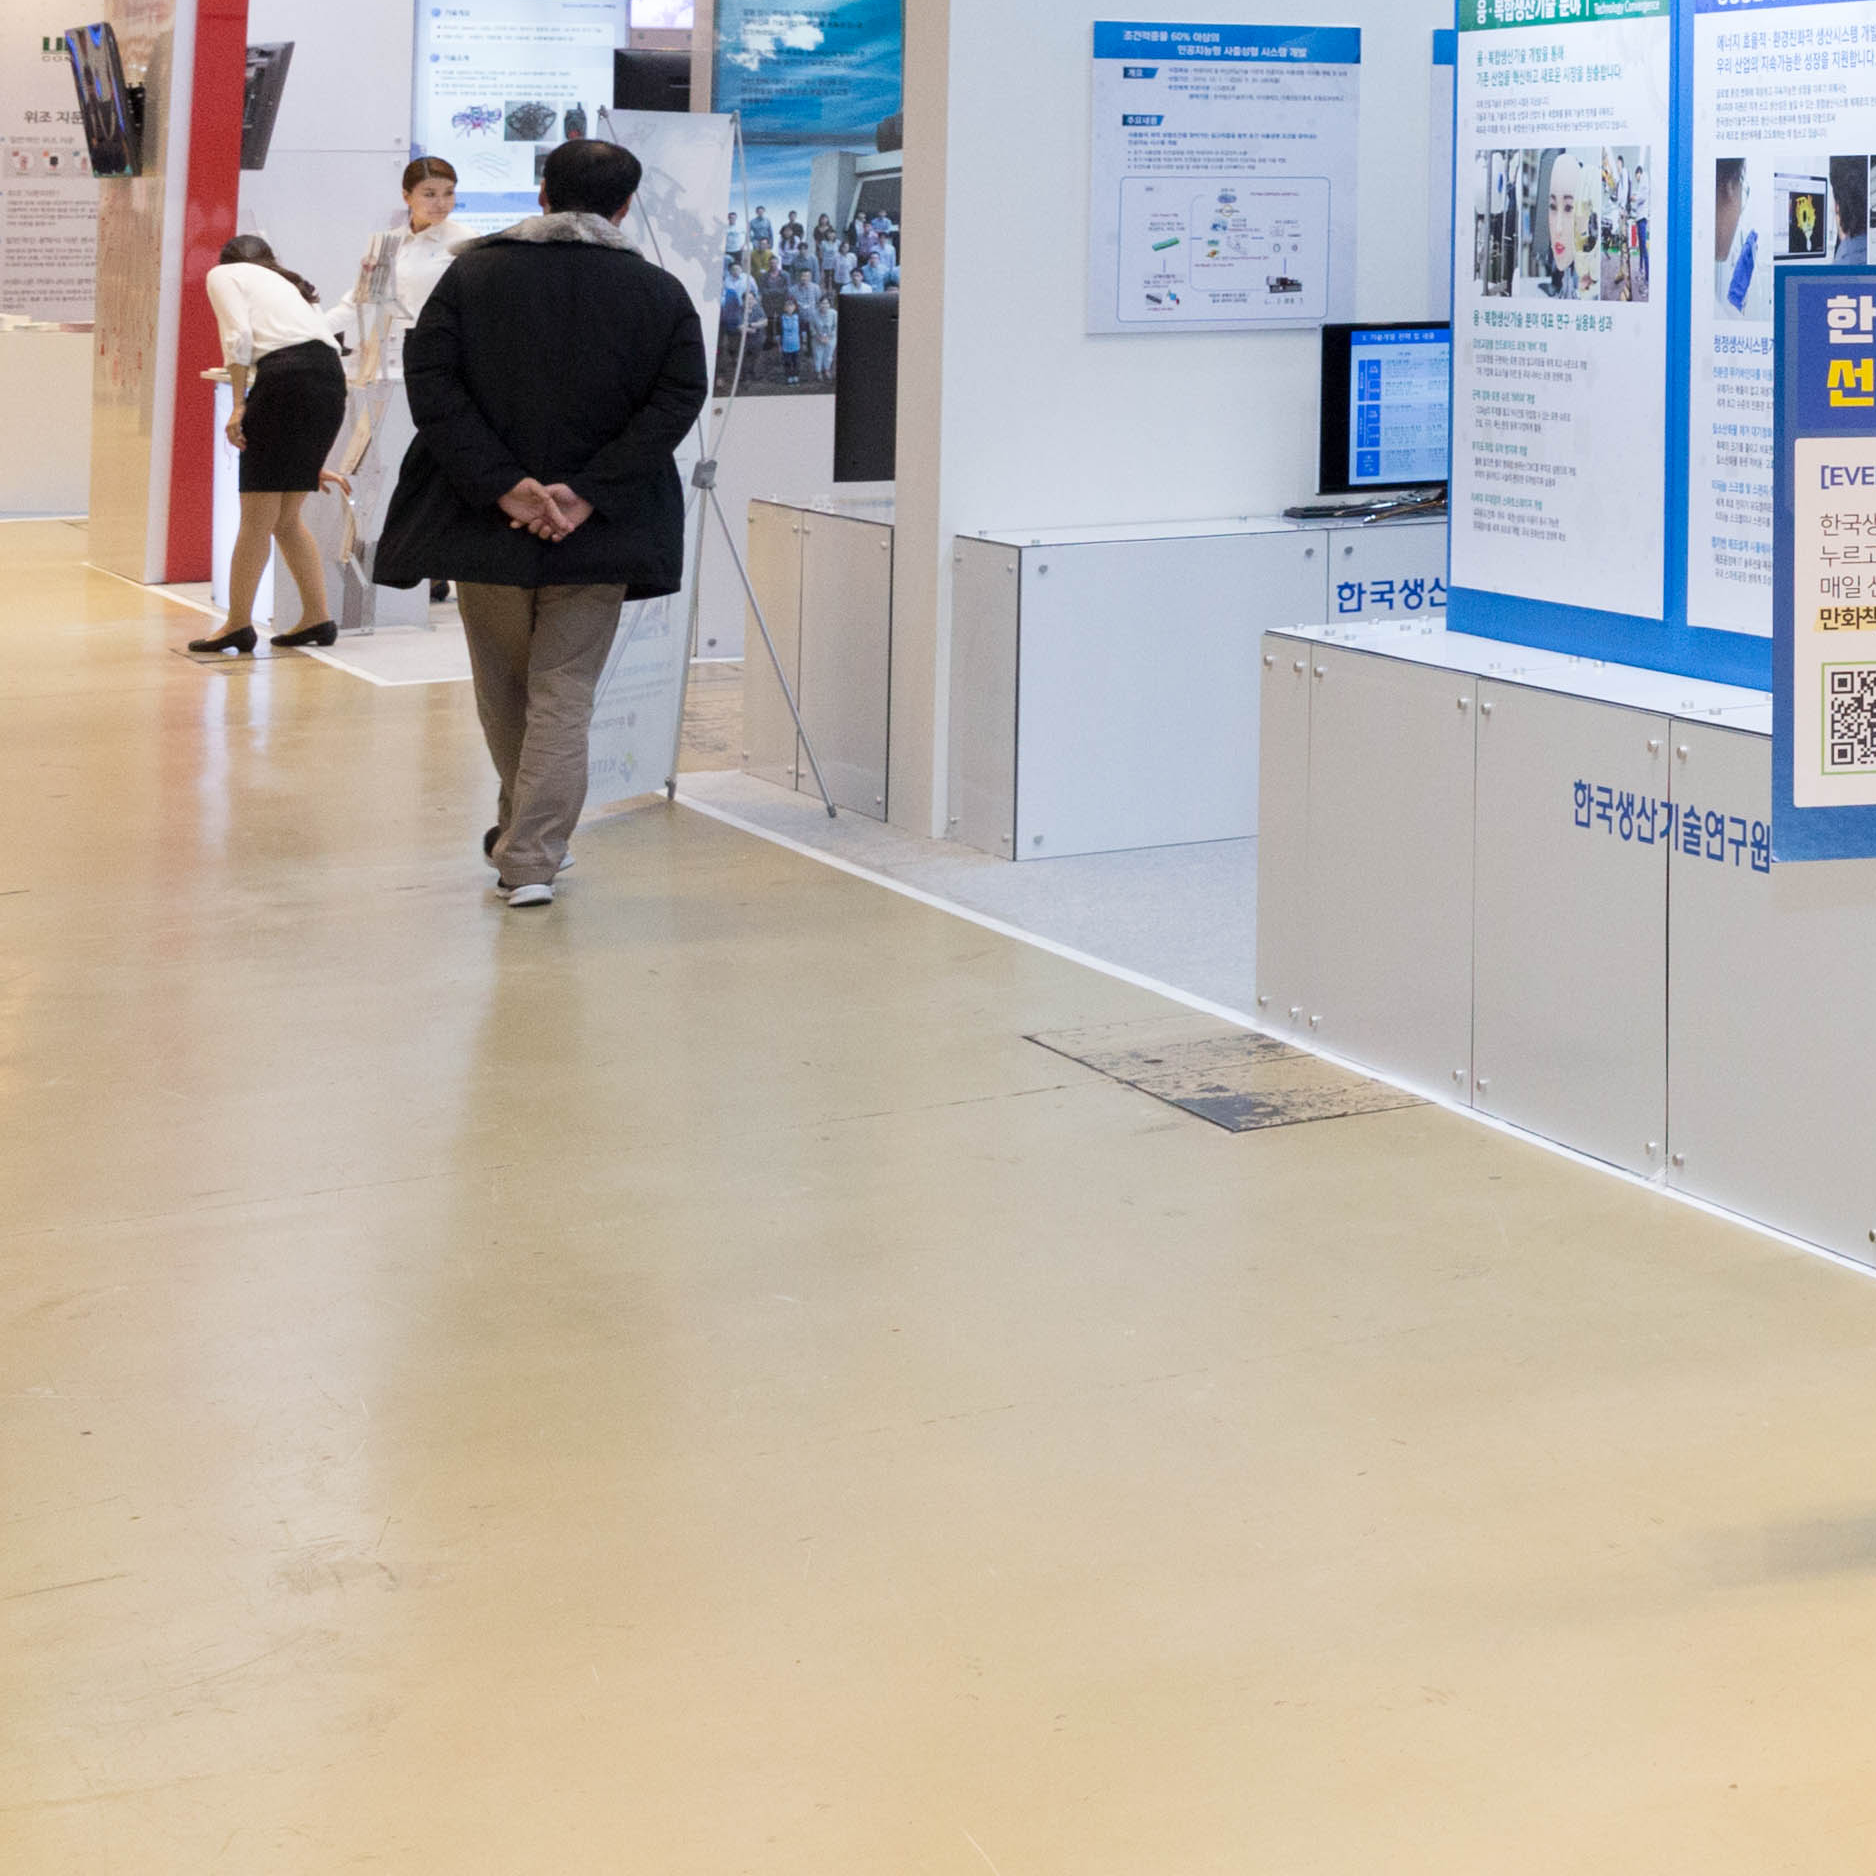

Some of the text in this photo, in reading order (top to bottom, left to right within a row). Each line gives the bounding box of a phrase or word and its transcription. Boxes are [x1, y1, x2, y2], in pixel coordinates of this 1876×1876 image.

[1171, 31, 1190, 42] 60%
[1820, 574, 1862, 599] 매일
[1573, 779, 1771, 874] 한국생산기술연구원
